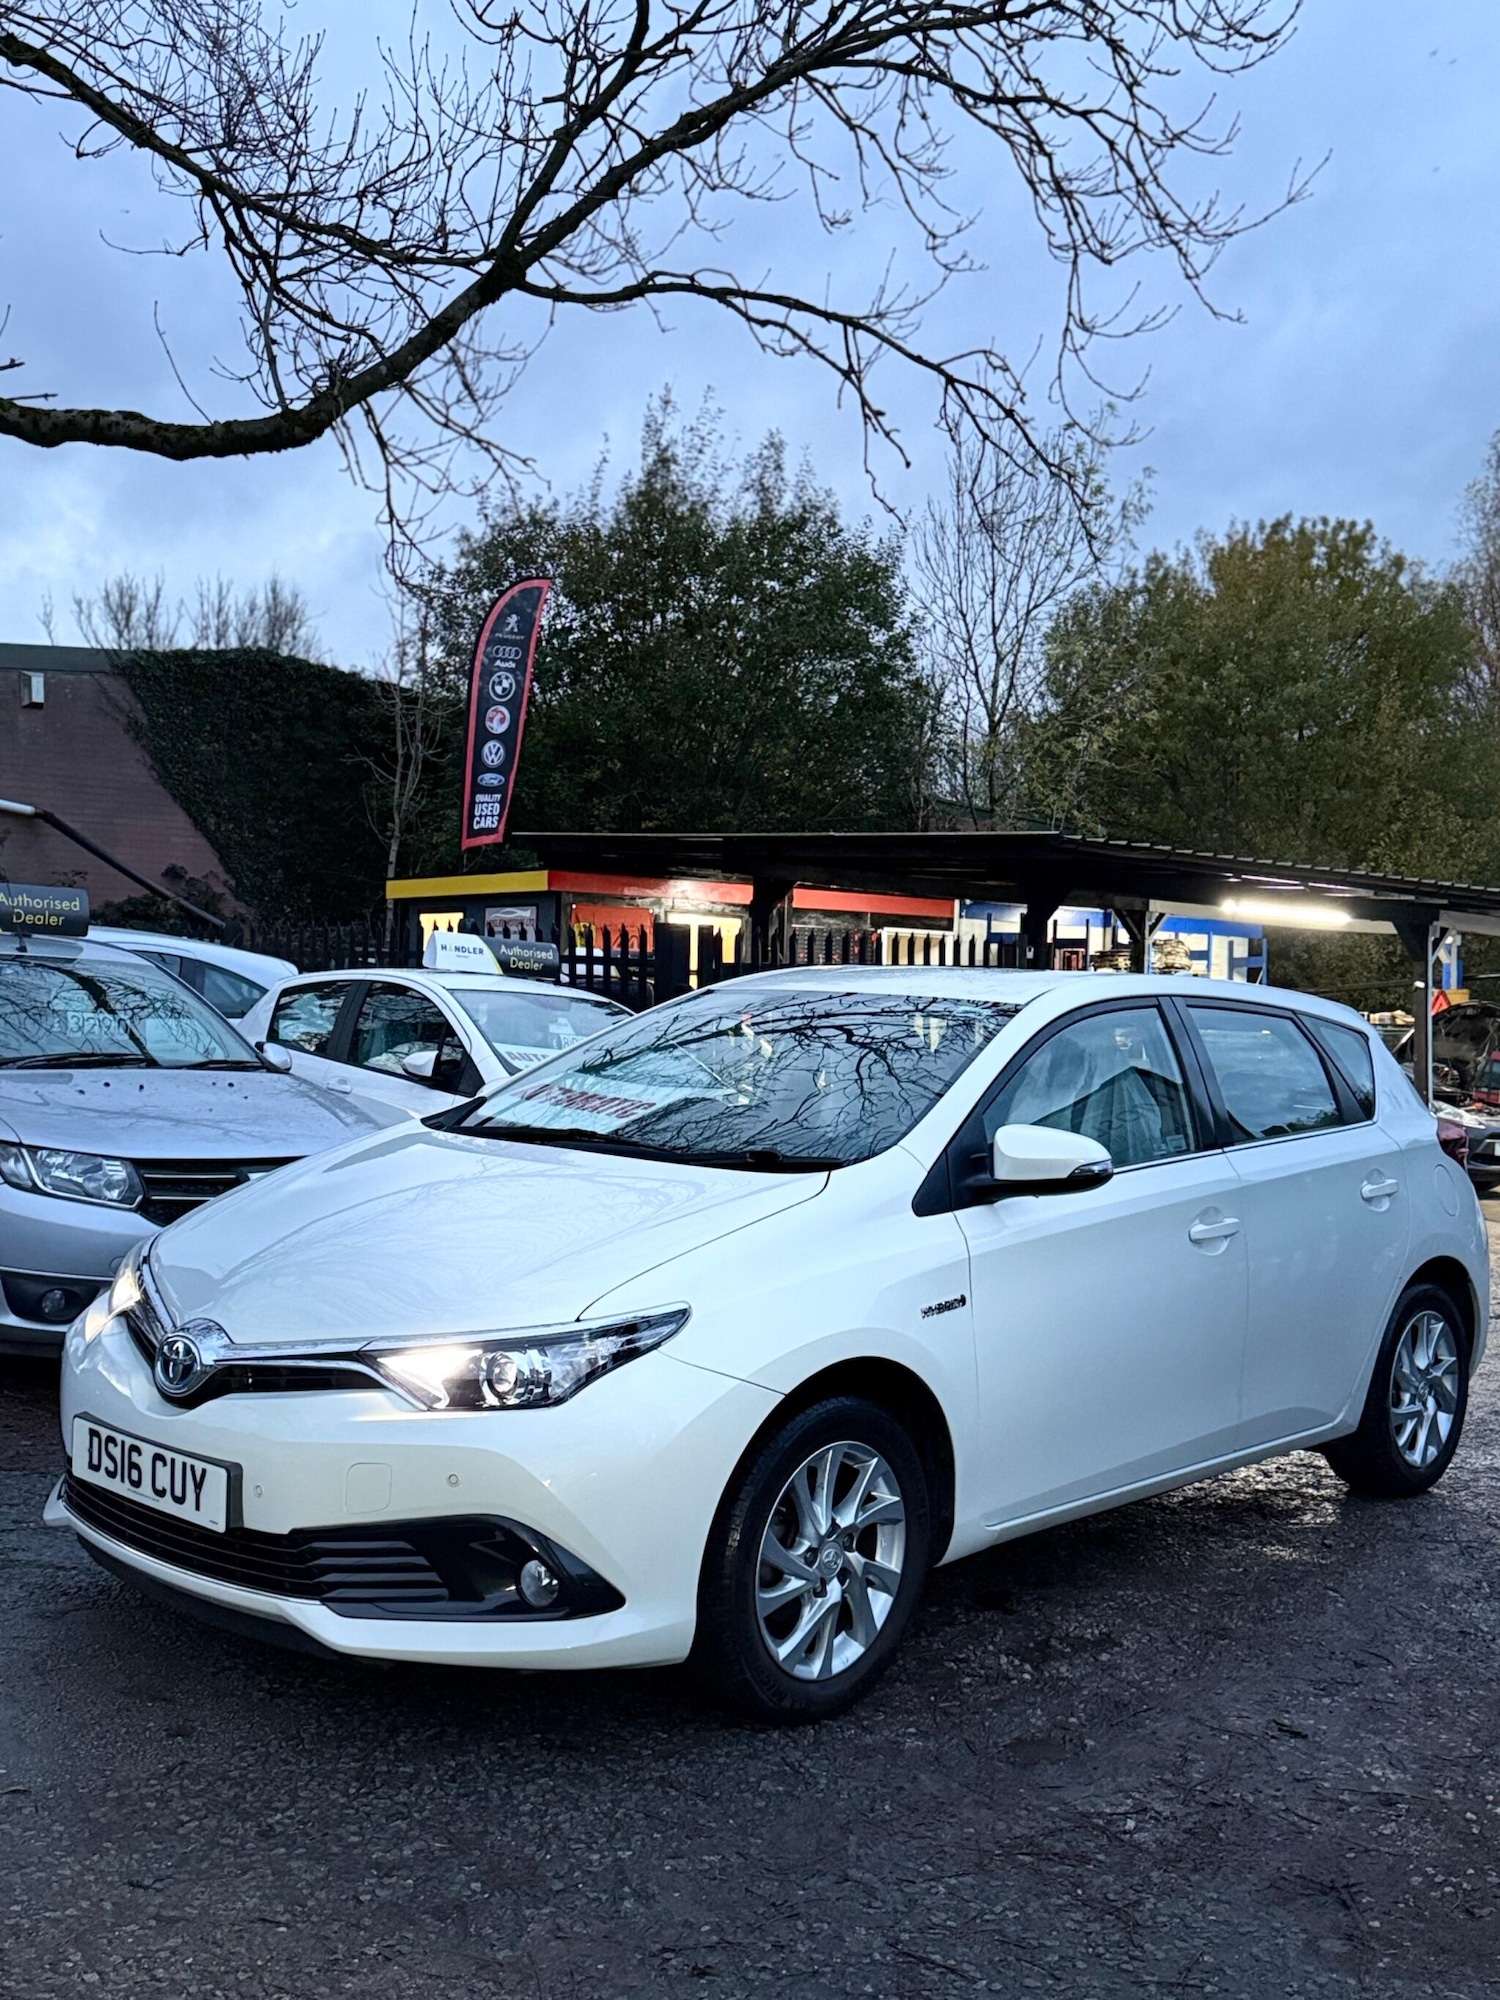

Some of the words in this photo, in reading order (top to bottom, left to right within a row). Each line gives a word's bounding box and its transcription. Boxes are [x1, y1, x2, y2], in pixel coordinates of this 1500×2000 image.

[494, 659, 516, 668] Audi
[475, 794, 502, 803] QUALITY
[474, 803, 500, 816] USED
[473, 816, 499, 830] CARS
[0, 892, 80, 911] Authorised
[12, 908, 65, 926] Dealer
[441, 943, 484, 955] HANDLER
[500, 944, 553, 960] Authorised
[510, 956, 543, 971] Dealer
[88, 1428, 142, 1489] DS16
[151, 1452, 207, 1512] CUY
